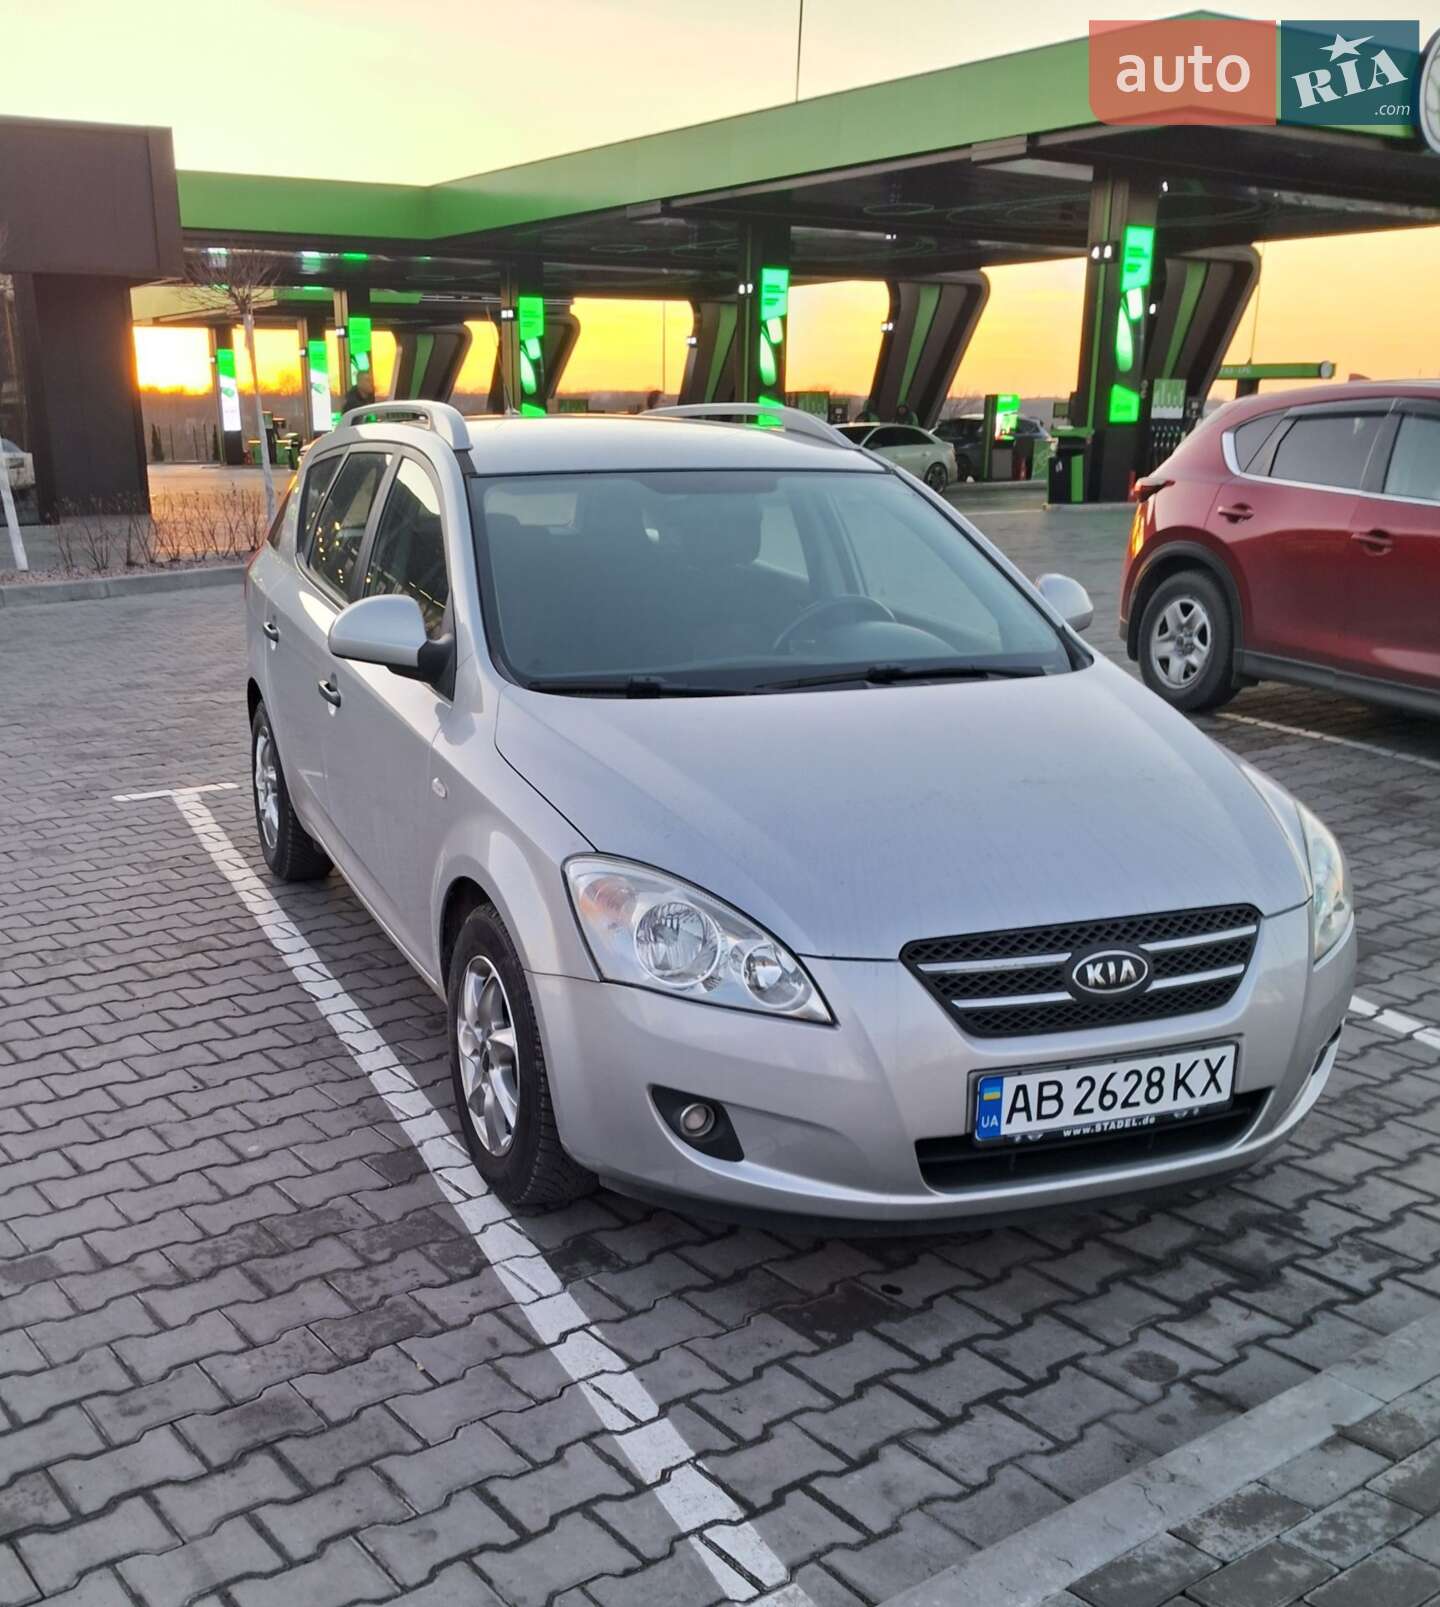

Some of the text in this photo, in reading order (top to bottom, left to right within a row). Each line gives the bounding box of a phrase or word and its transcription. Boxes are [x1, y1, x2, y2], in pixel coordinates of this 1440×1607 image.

[1087, 959, 1137, 986] KIA
[1005, 1055, 1227, 1125] AB 2628 KX
[981, 1115, 999, 1129] UA
